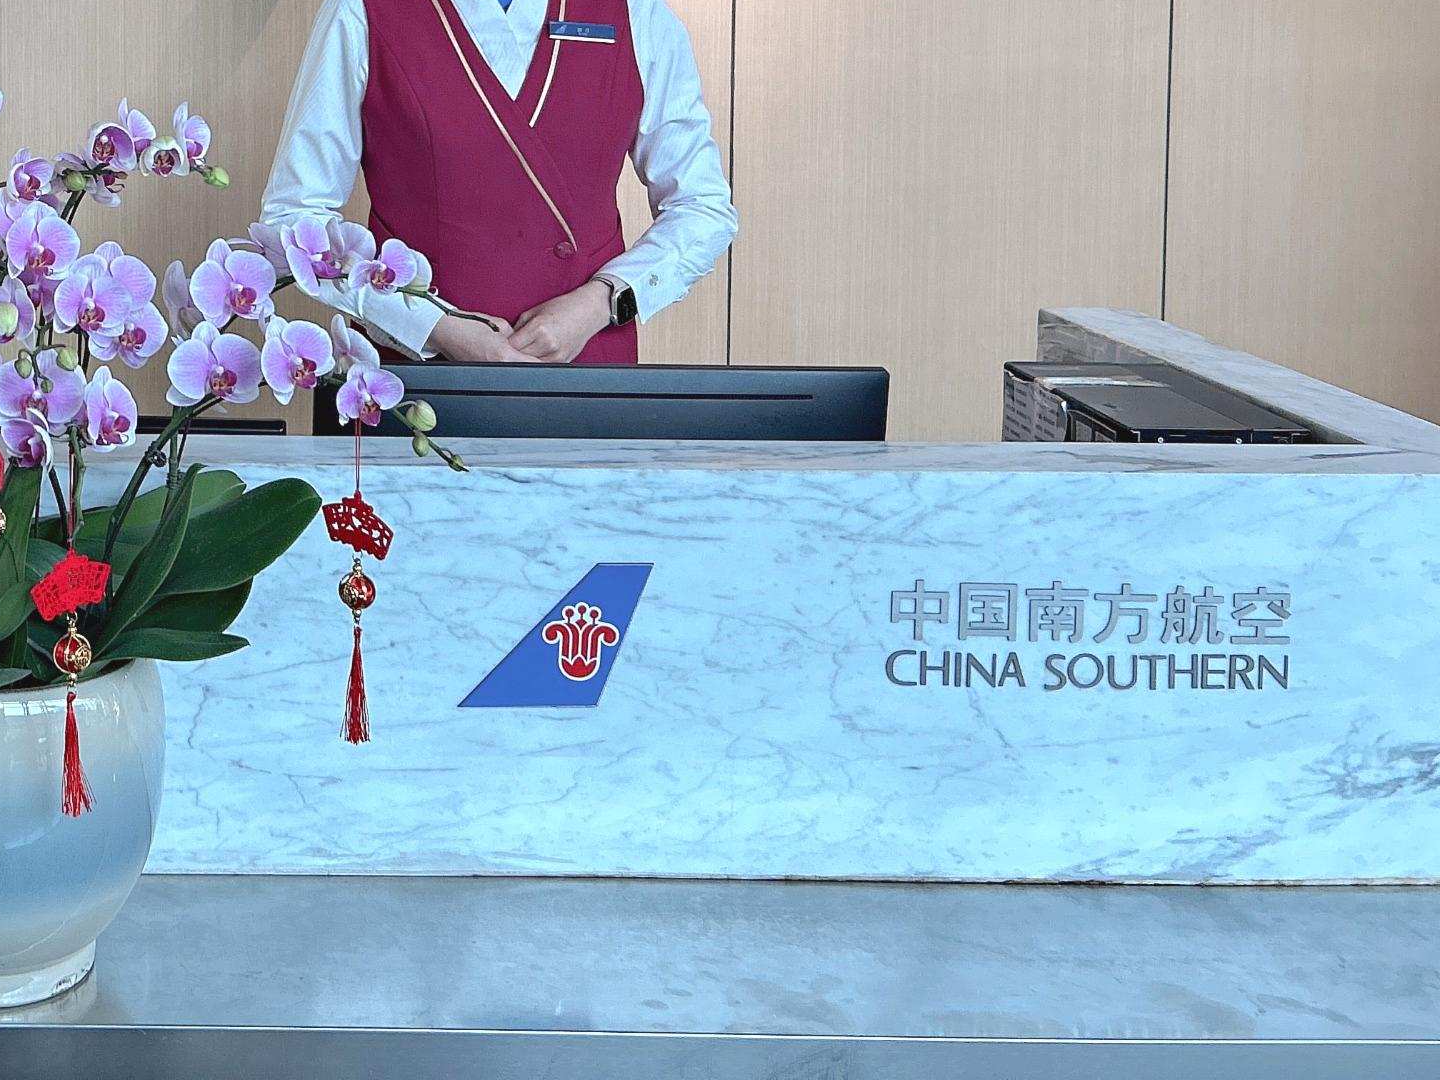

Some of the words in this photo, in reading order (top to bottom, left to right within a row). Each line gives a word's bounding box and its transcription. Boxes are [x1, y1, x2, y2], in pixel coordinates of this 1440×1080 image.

[890, 579, 1292, 645] 中国南方航空
[885, 649, 1027, 688] CHINA
[1043, 651, 1289, 691] SOUTHERN
